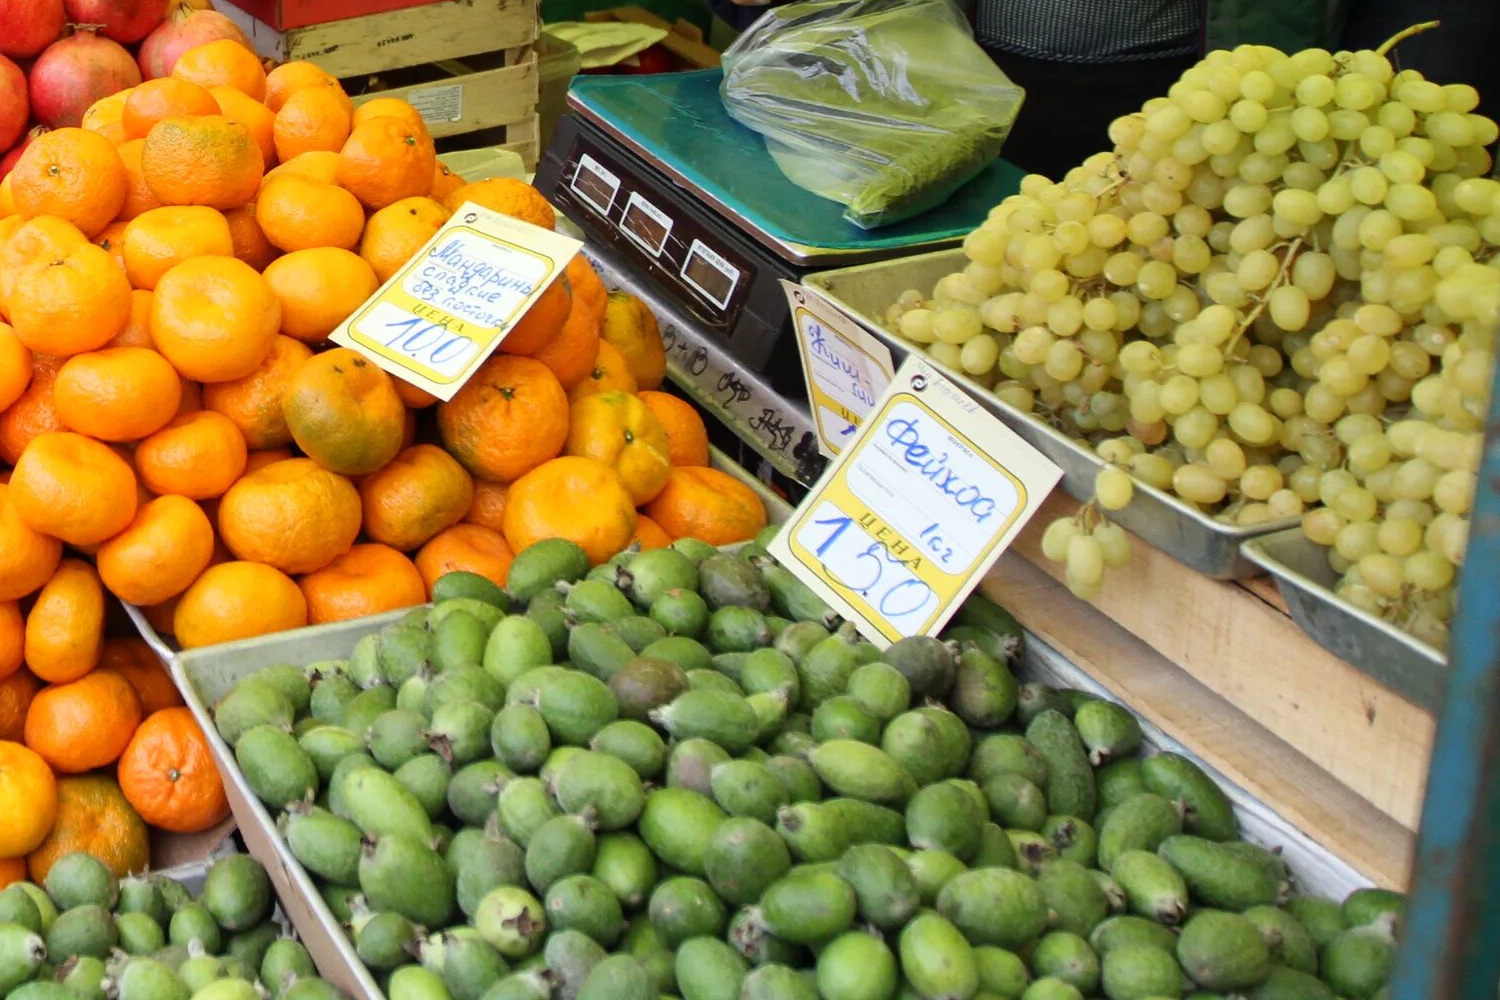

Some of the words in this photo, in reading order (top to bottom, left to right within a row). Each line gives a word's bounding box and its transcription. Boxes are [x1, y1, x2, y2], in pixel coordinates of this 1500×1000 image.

[412, 303, 464, 333] ЦЕНА
[840, 407, 861, 426] ЦЕ
[886, 417, 996, 525] Фейхоа
[858, 511, 923, 571] ЦЕНА
